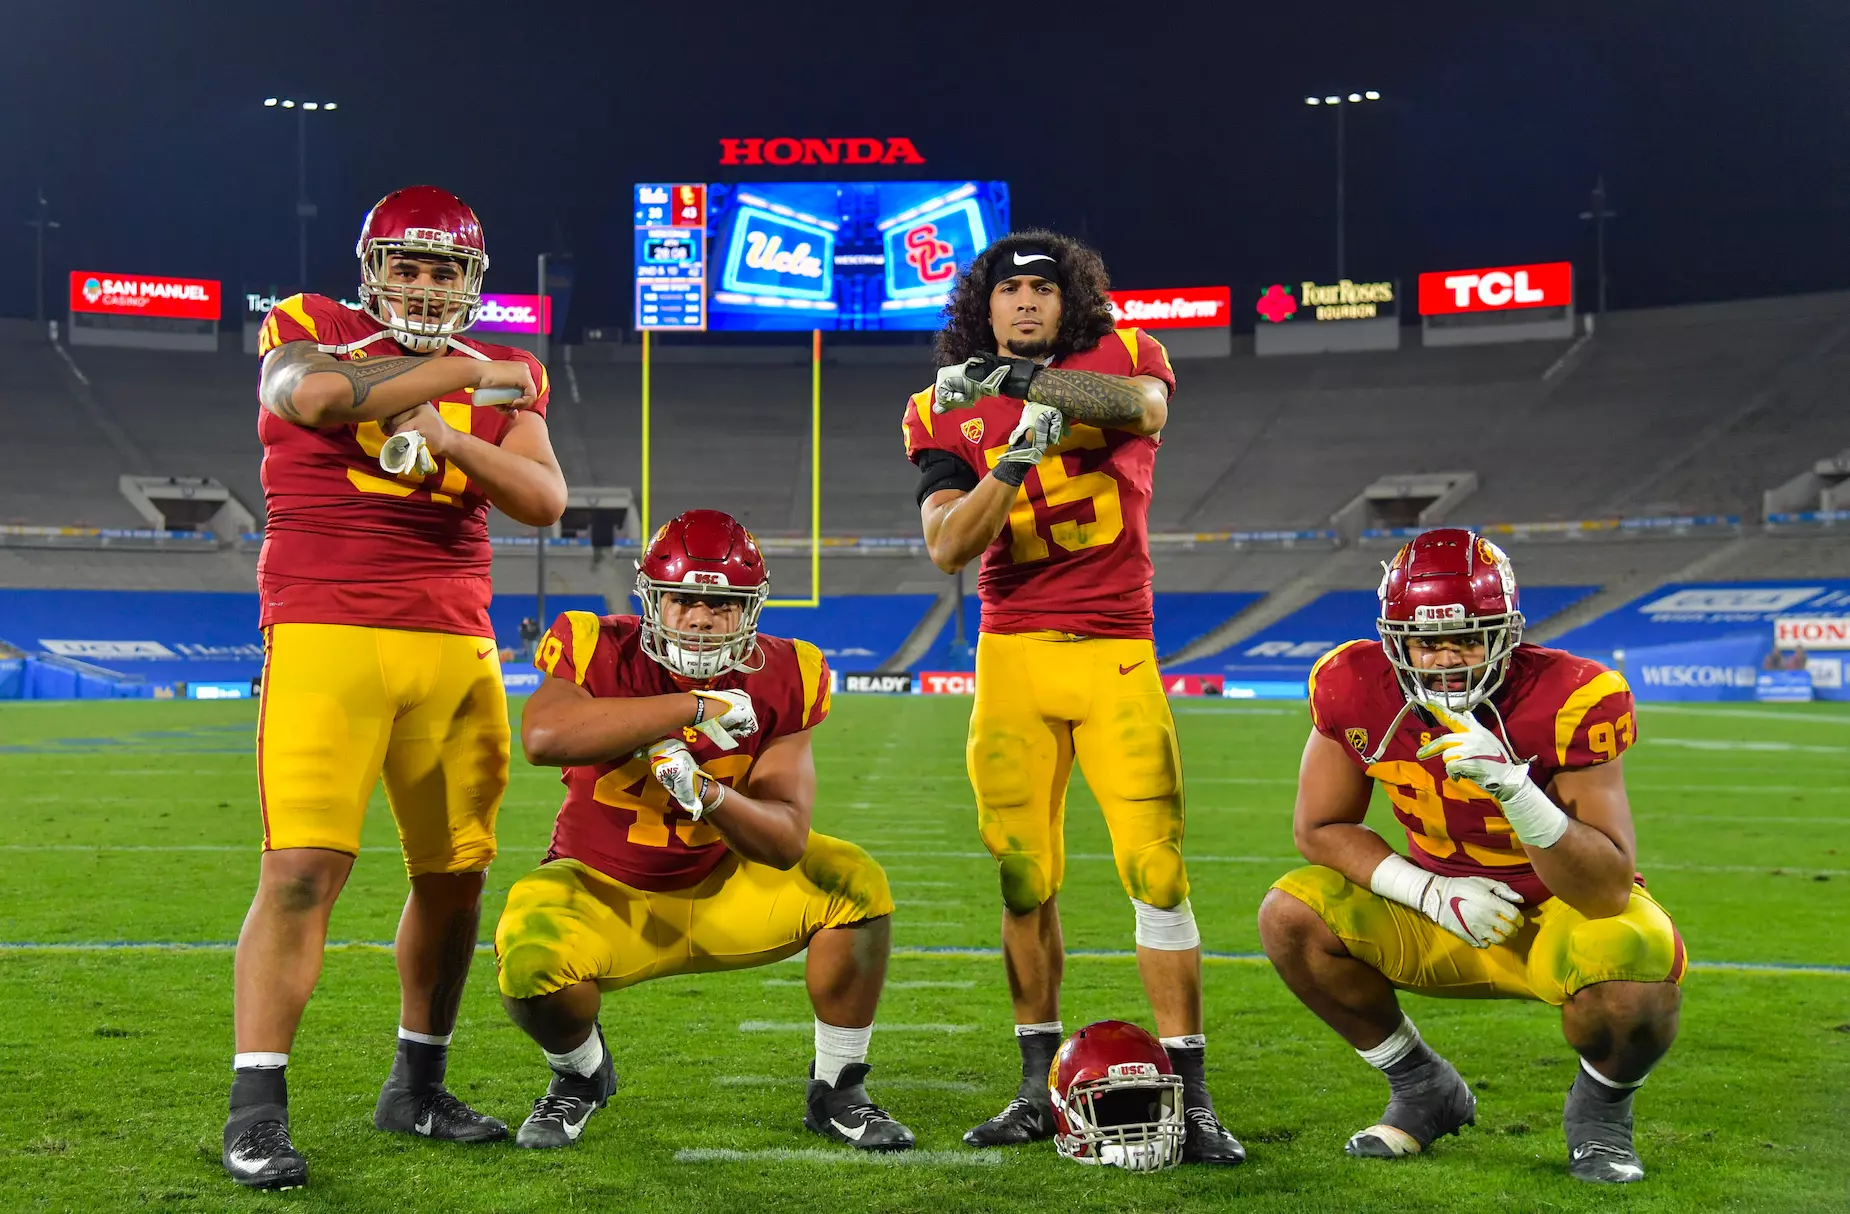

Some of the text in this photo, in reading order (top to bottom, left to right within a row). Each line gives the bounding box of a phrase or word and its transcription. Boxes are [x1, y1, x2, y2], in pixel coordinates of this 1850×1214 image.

[719, 138, 926, 164] HONDA
[417, 229, 442, 241] USC
[102, 279, 209, 301] SAN MANUEL
[1444, 270, 1544, 308] TCL
[102, 296, 146, 307] CASINO
[984, 422, 1124, 565] 15
[694, 573, 719, 585] USC
[1426, 607, 1454, 620] USC
[847, 676, 905, 692] READY
[928, 678, 975, 693] TCL
[1642, 666, 1734, 687] WESCOM
[1588, 711, 1633, 764] 93
[1365, 760, 1530, 866] 93
[1120, 1064, 1146, 1076] USC
